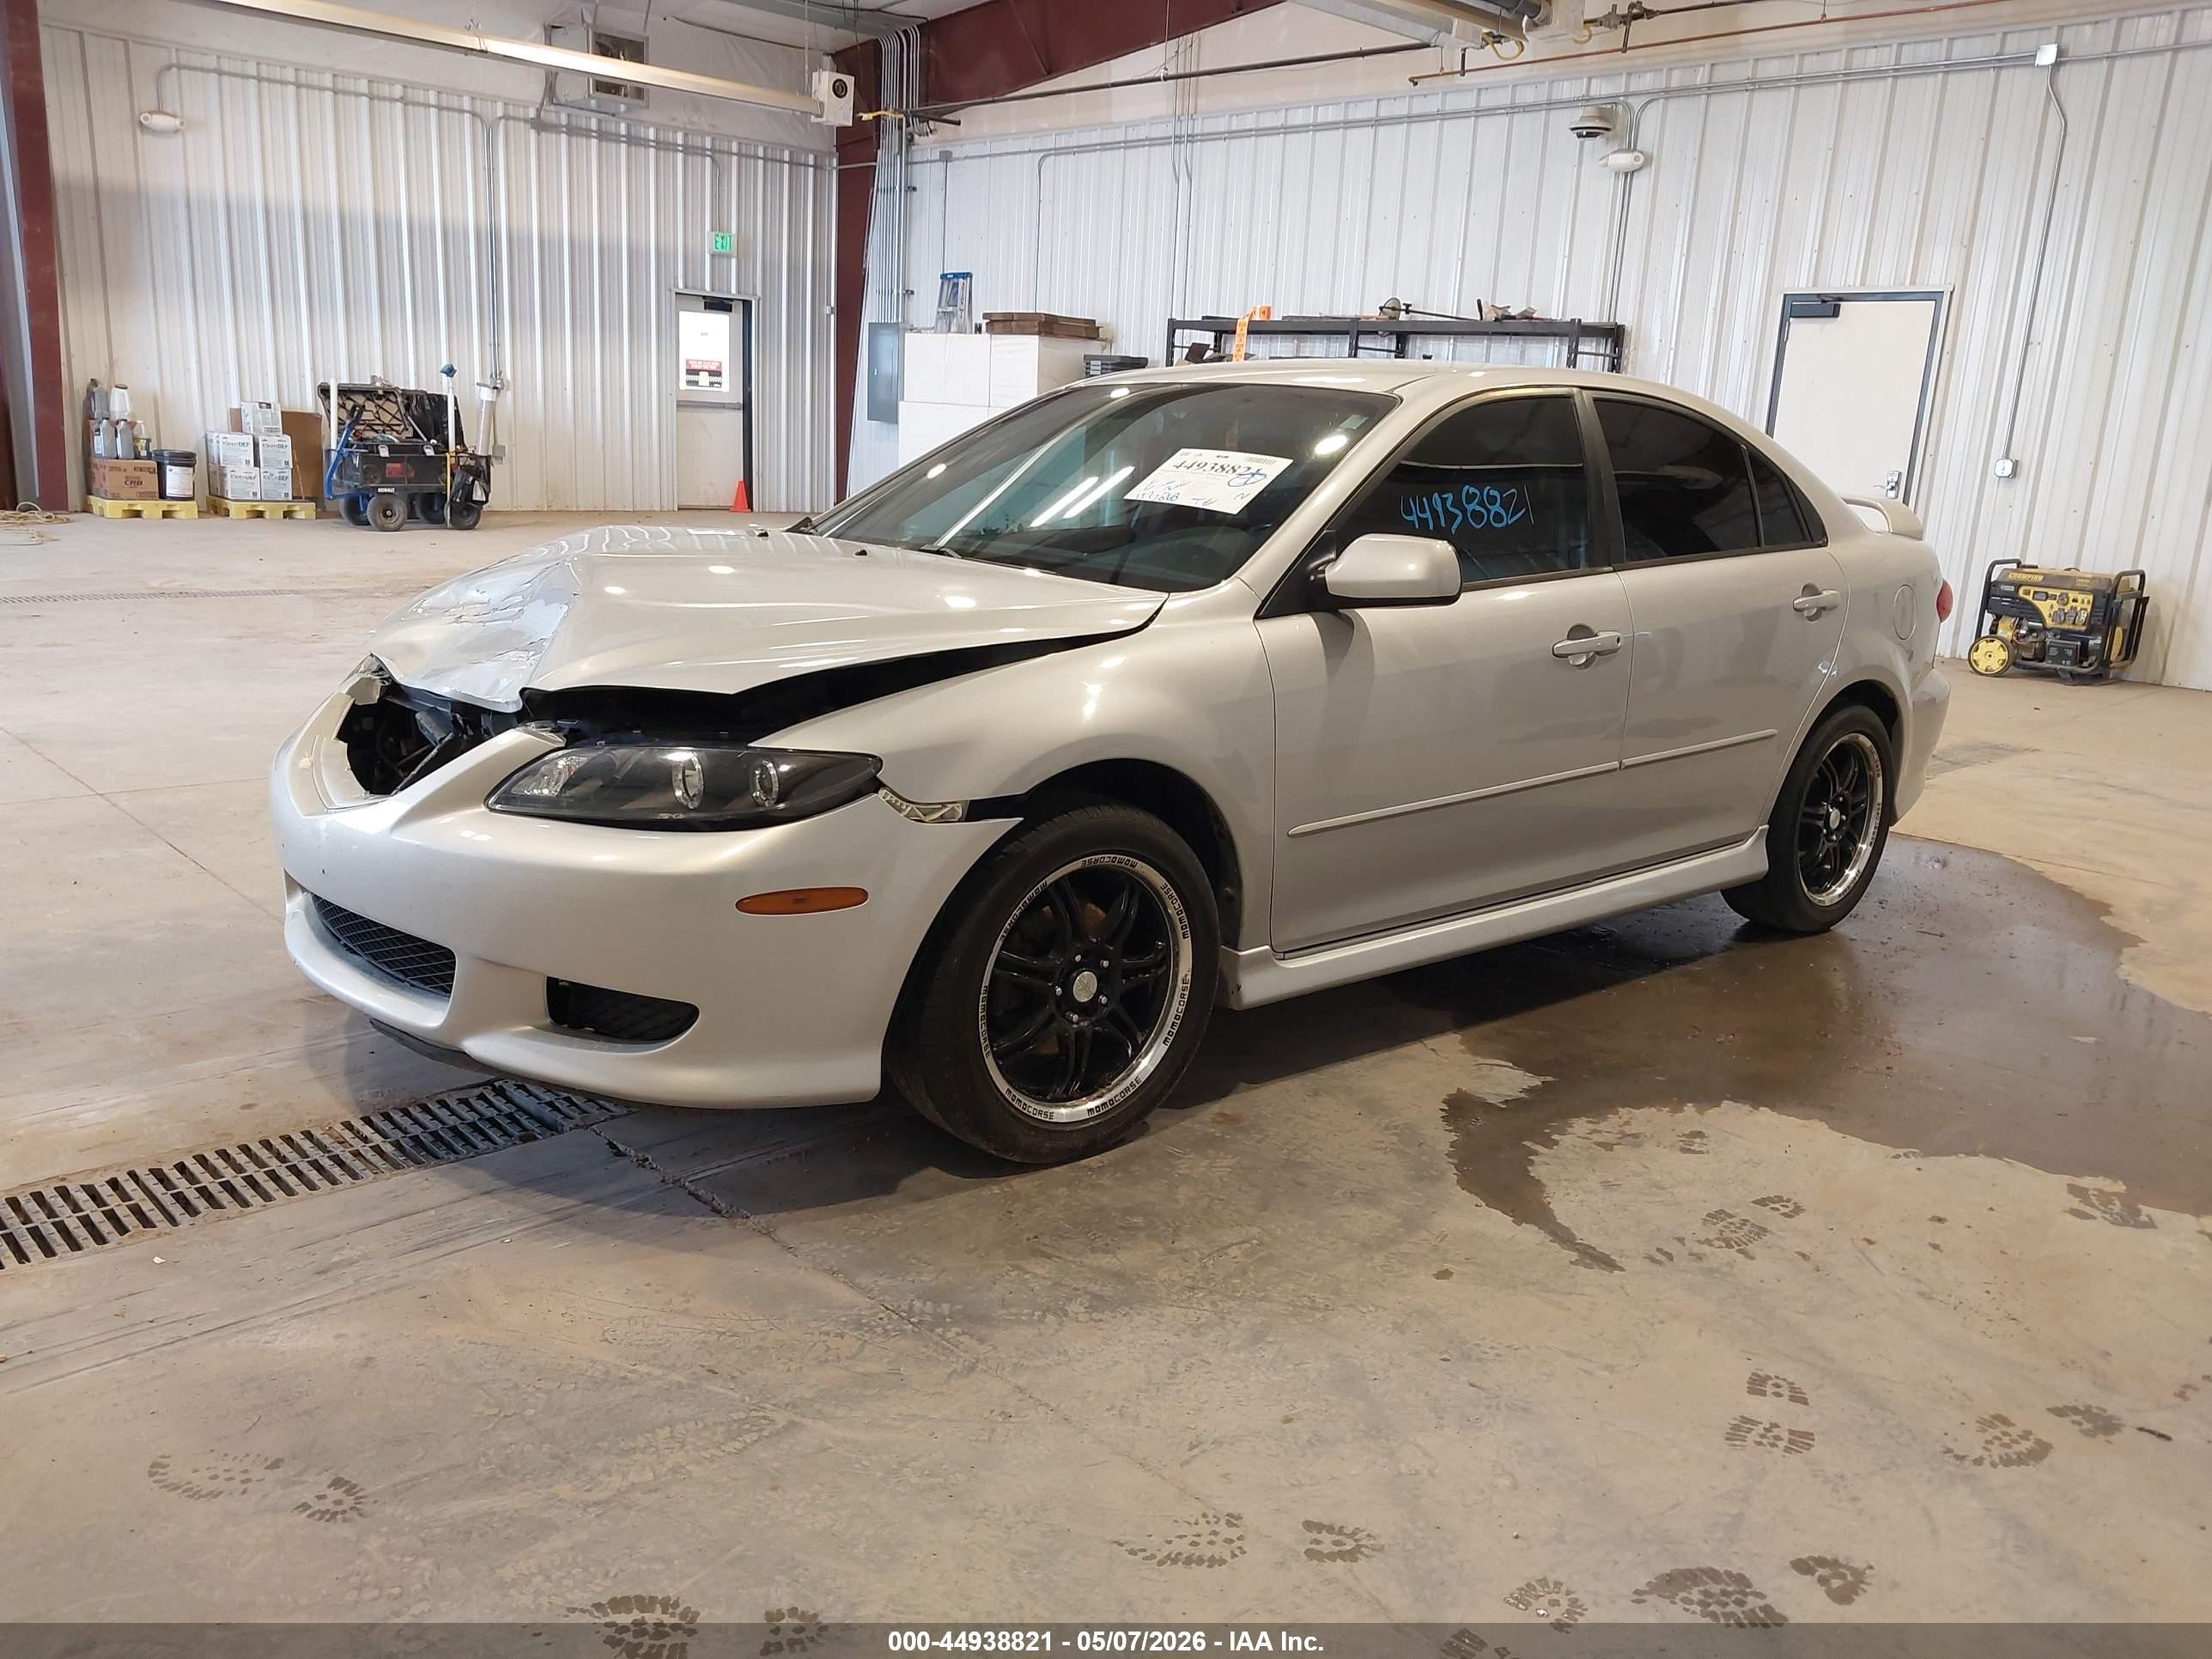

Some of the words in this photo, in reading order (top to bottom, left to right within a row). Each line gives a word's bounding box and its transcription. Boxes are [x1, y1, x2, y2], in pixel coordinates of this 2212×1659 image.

[714, 234, 732, 251] EXIT
[1401, 483, 1534, 535] 44938821
[2008, 572, 2045, 583] CHAMPION
